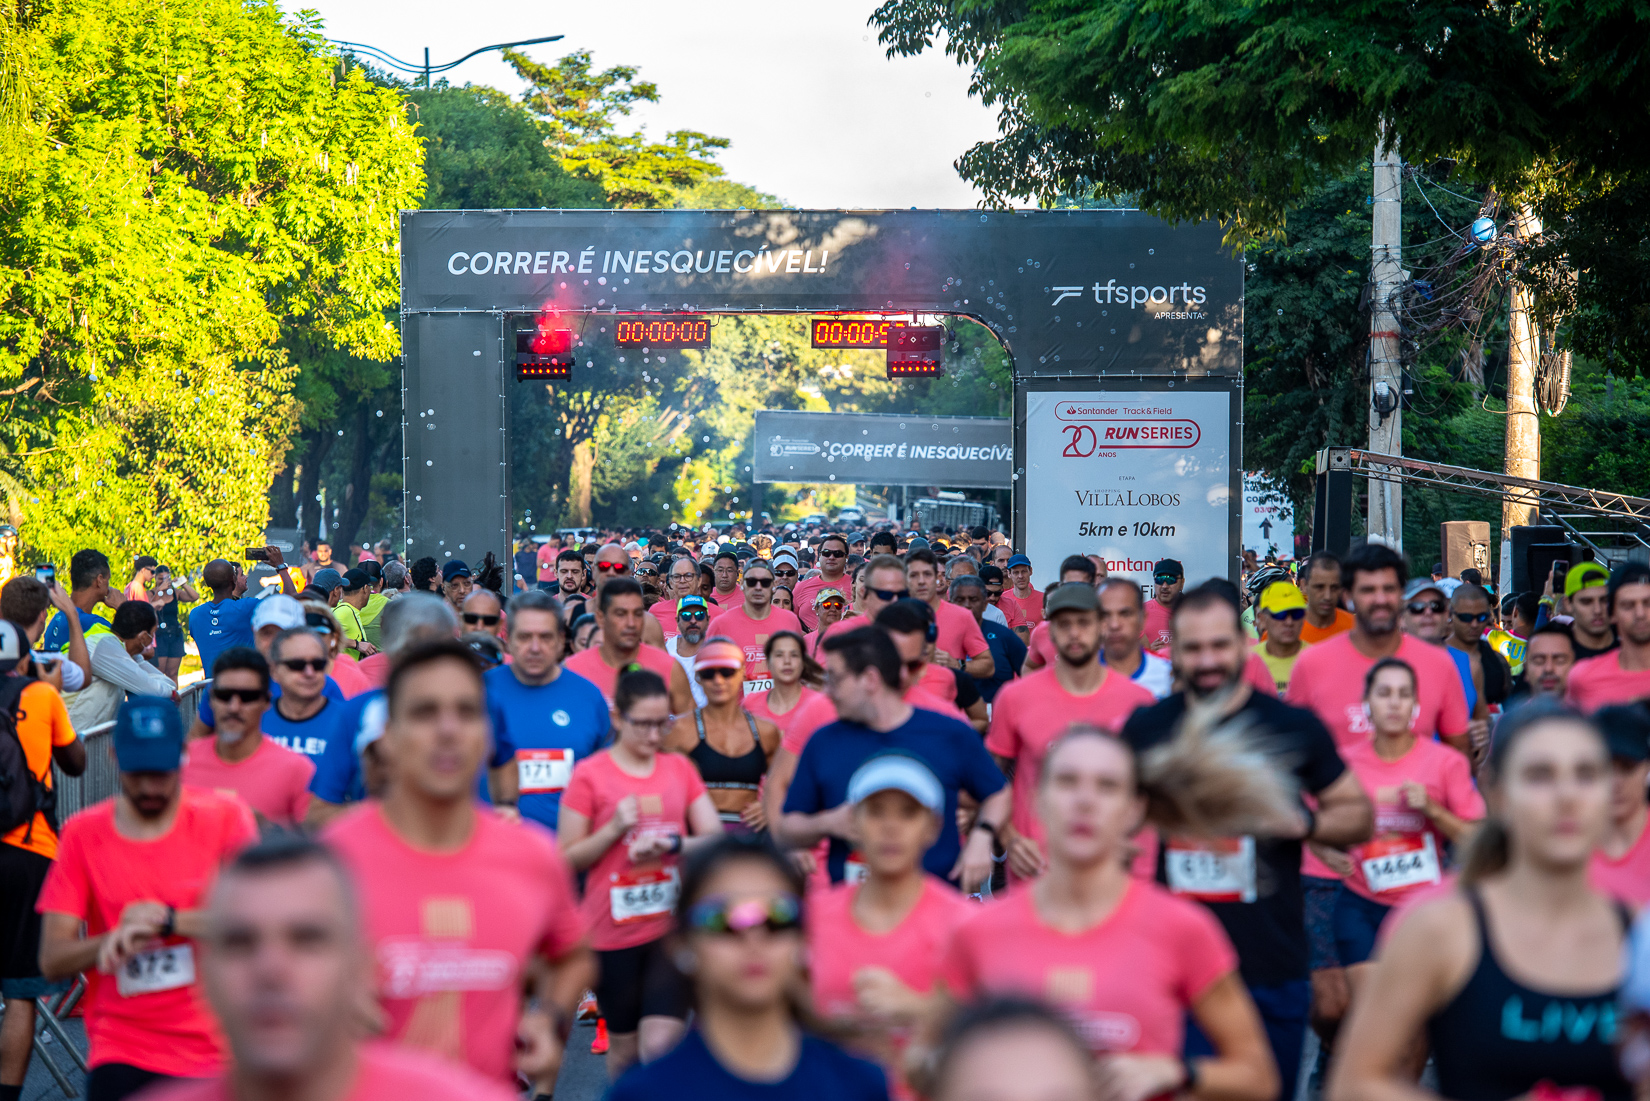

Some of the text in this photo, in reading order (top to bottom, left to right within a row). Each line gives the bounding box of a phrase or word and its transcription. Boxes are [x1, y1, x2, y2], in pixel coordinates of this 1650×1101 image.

[447, 245, 829, 275] CORRER É INESQUECÍVEL!
[1092, 278, 1206, 309] tfsports
[1154, 311, 1205, 320] APRESENTA:
[617, 321, 707, 342] 00:00:00
[815, 321, 905, 344] 00:00:5
[1077, 407, 1119, 415] Santander
[829, 442, 1013, 461] CORRER É INESQUECÍVE
[1061, 425, 1097, 458] 20
[1078, 521, 1176, 537] 5km e 10km
[749, 681, 772, 691] 770
[524, 763, 552, 778] 171
[1372, 855, 1423, 876] 1464
